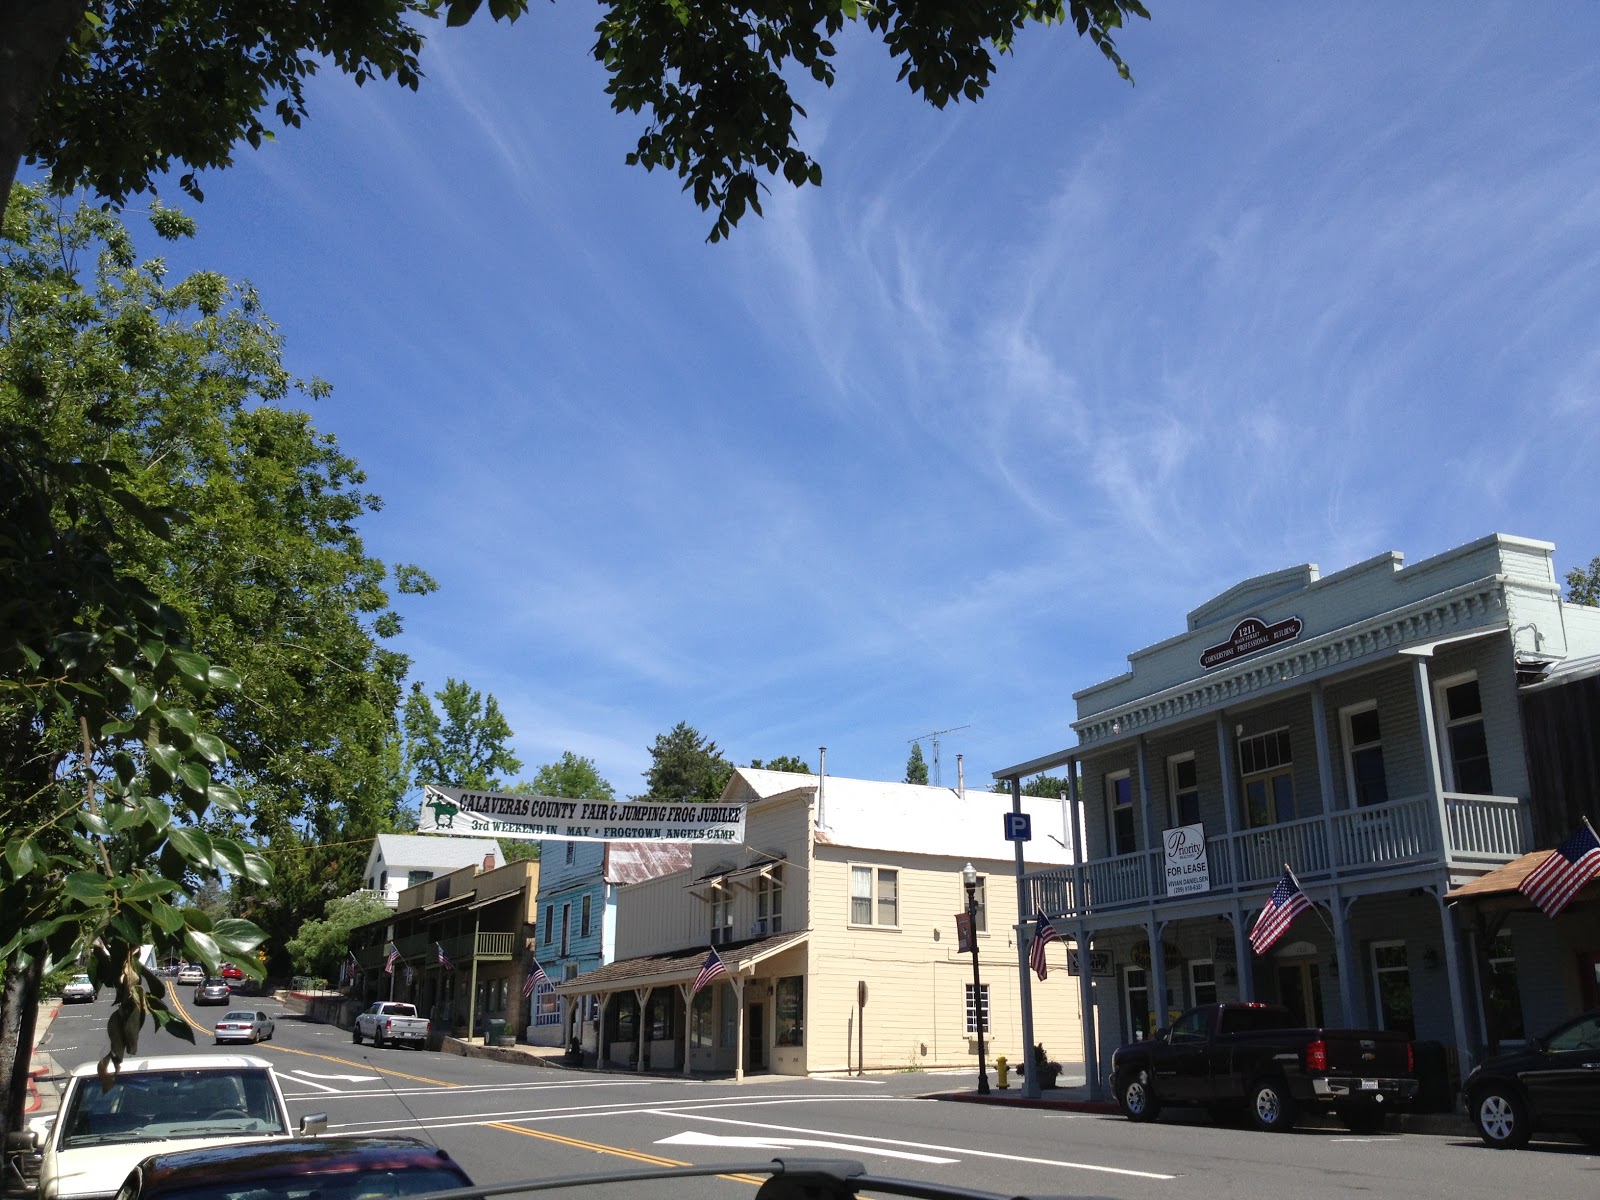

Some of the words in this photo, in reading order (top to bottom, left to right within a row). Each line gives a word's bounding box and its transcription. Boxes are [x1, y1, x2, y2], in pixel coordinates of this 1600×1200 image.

[1239, 625, 1255, 636] 1211
[1205, 648, 1234, 664] CORNERSTONE
[1237, 635, 1269, 652] PROFESSIONAL
[1274, 626, 1295, 639] BUILDING
[460, 794, 529, 816] CALAVERAS
[531, 799, 577, 819] COUNTY
[580, 803, 609, 820] FAIR
[609, 805, 617, 821] &
[618, 805, 667, 822] JUMPING
[667, 806, 697, 822] FROG
[697, 807, 741, 823] JUBILEE
[471, 820, 489, 831] 3rd
[492, 821, 543, 835] WEEKEND
[546, 825, 558, 835] IN
[566, 826, 591, 836] MAY
[666, 829, 704, 839] ANGELS
[707, 829, 735, 840] CAMP
[1012, 817, 1026, 836] P
[1168, 831, 1201, 858] Priority
[1167, 867, 1182, 877] FOR
[1183, 862, 1206, 875] LEASE
[1168, 879, 1183, 887] VIVIAN
